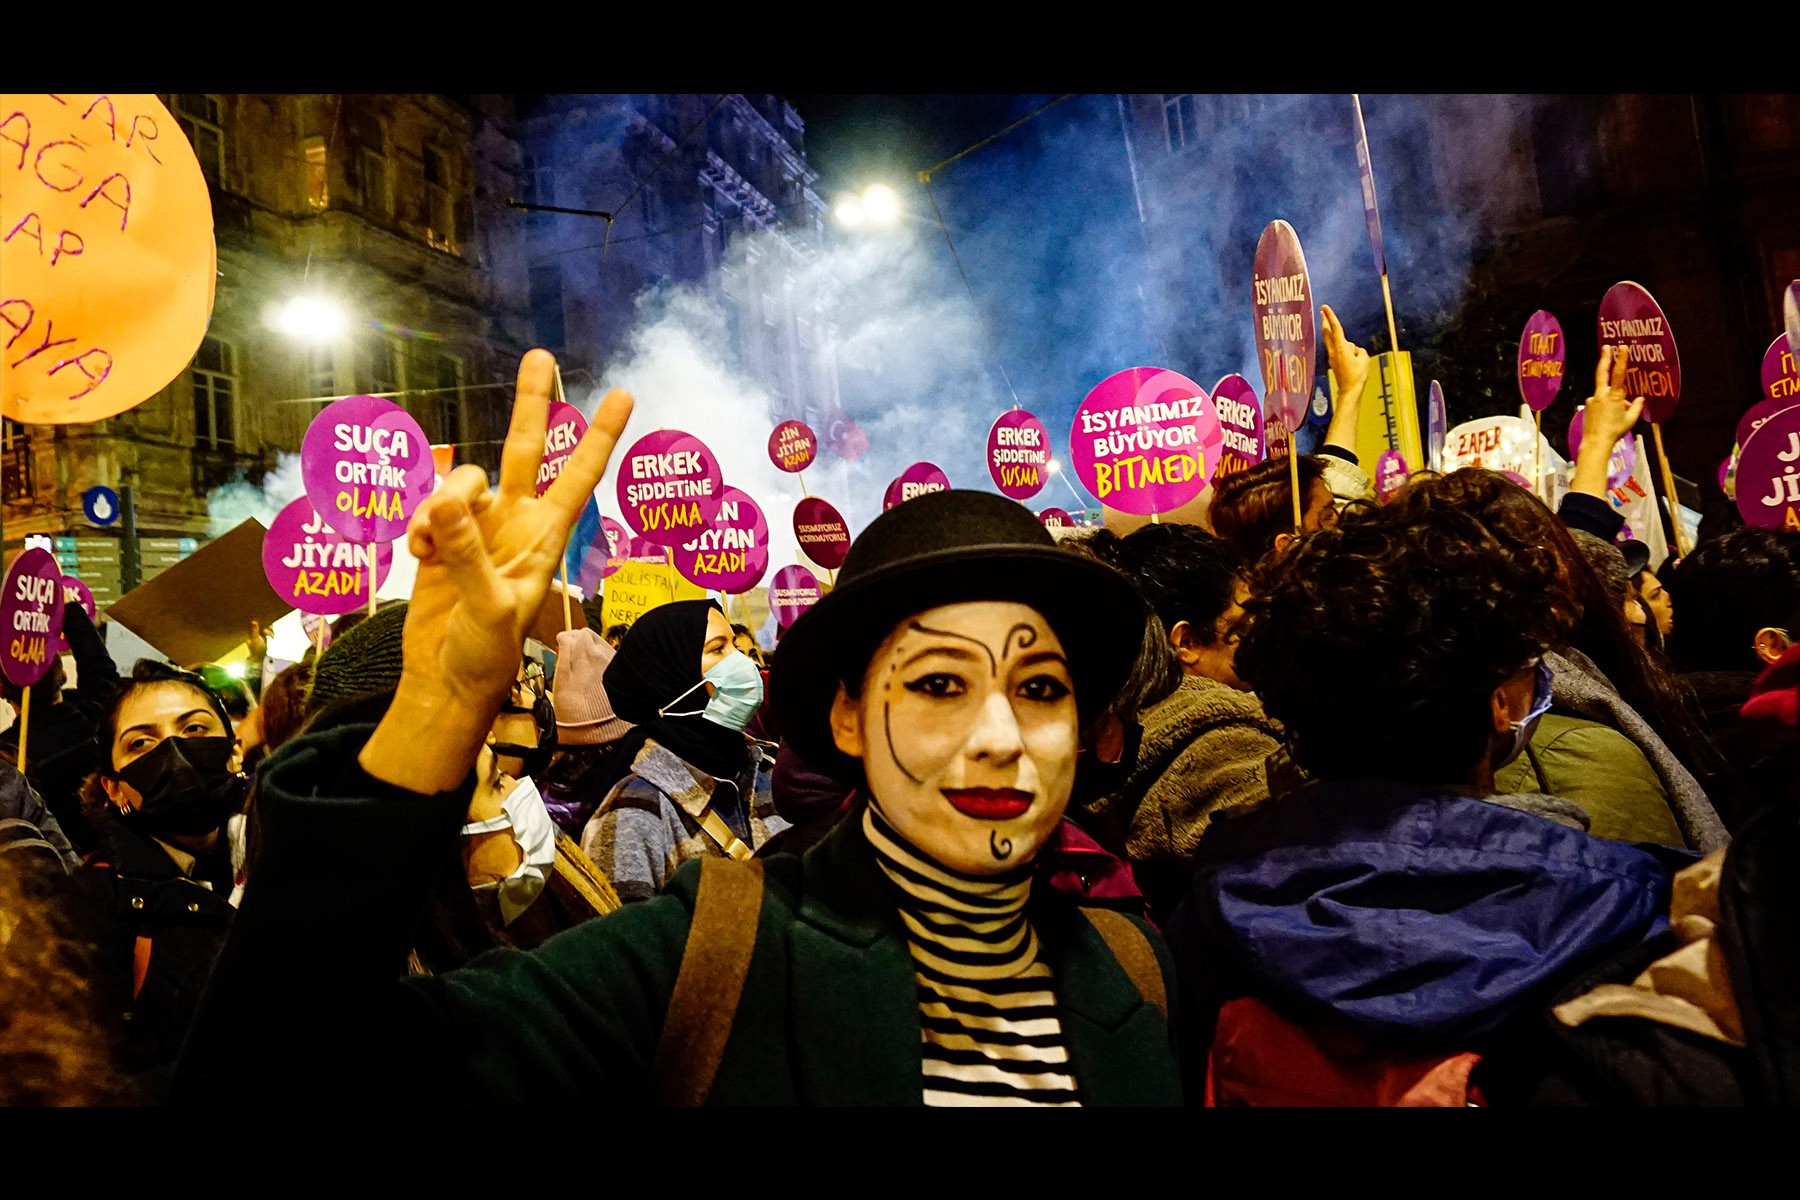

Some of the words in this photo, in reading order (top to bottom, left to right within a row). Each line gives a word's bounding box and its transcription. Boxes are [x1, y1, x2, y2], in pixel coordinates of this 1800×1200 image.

[48, 94, 163, 165] AR
[1255, 273, 1305, 305] İSYANIMIZ
[1262, 307, 1303, 341] BÜYÜYOR
[1600, 316, 1664, 339] İSYANIMIZ
[1081, 396, 1204, 434] İSYANIMIZ
[1216, 395, 1256, 430] ERKEK
[333, 423, 409, 465] SUÇA
[776, 437, 811, 458] JİYAN
[779, 426, 800, 442] JİN
[997, 427, 1040, 447] ERKEK
[1093, 424, 1199, 458] BÜYÜYOR
[335, 460, 407, 488] ORTAK
[632, 451, 703, 479] ERKEK
[1000, 465, 1039, 487] SUSMA
[1093, 445, 1206, 498] BİTMEDİ
[335, 487, 404, 521] OLMA
[627, 478, 713, 507] ŞİDDETİNE
[639, 501, 703, 533] SUSMA
[282, 536, 371, 568] JİYAN
[693, 548, 746, 576] AZADİ
[15, 574, 55, 613] SUÇA
[293, 567, 361, 597] AZADİ
[13, 610, 51, 633] ORTAK
